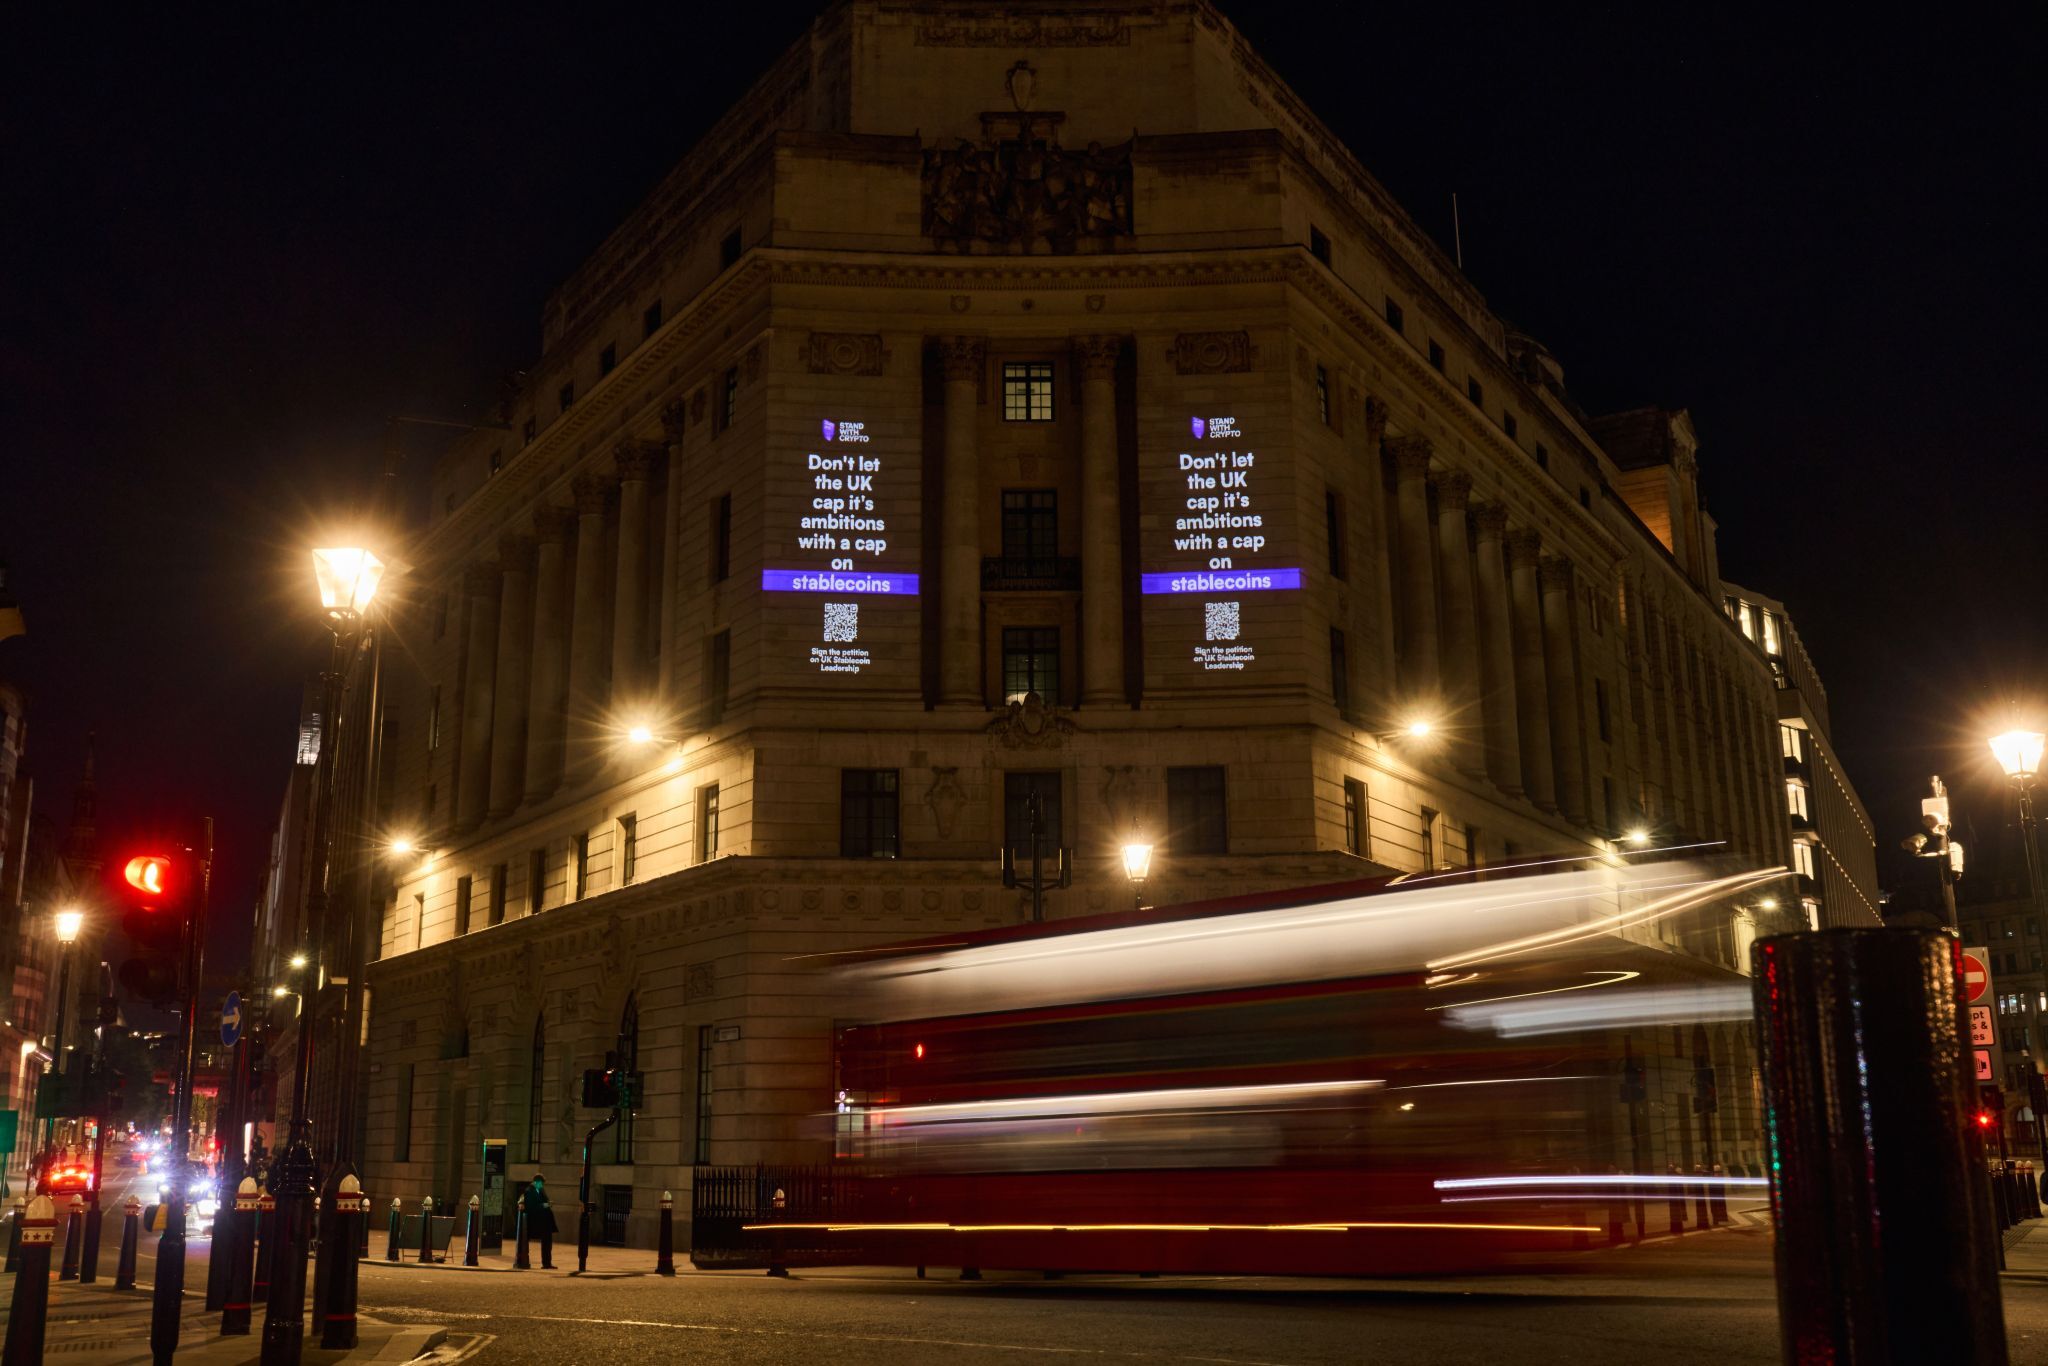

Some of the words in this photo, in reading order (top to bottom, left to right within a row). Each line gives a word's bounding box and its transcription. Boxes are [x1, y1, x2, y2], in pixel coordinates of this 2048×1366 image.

[1209, 417, 1235, 425] STAND
[1209, 424, 1231, 432] WITH
[1210, 430, 1241, 438] CRYPTO
[808, 454, 855, 472] Don't
[858, 455, 881, 472] let
[1179, 453, 1228, 470] Don't
[1232, 452, 1255, 468] let
[814, 474, 842, 490] the
[847, 475, 873, 491] UK
[1187, 474, 1216, 489] the
[1220, 472, 1247, 488] UK
[812, 497, 845, 514] cap
[849, 495, 874, 511] it's
[1186, 496, 1220, 513] cap
[1223, 492, 1250, 508] it's
[800, 514, 885, 531] ambitions
[1175, 513, 1263, 531] ambitions
[798, 534, 835, 550] with
[840, 538, 850, 550] a
[855, 537, 887, 556] cap
[1174, 534, 1212, 551] with
[1217, 537, 1228, 549] a
[1232, 535, 1265, 552] cap
[831, 557, 853, 571] on
[1209, 556, 1232, 570] on
[792, 574, 891, 593] stablecoins
[1171, 573, 1271, 592] stablecoins
[811, 648, 828, 657] Sign
[842, 649, 869, 657] petition
[1194, 646, 1210, 655] Sign
[1225, 646, 1252, 654] petition
[1217, 653, 1255, 661] Stablecoin
[820, 664, 860, 673] Leadership
[833, 656, 870, 664] Stablecoin
[1204, 661, 1244, 671] Leadership
